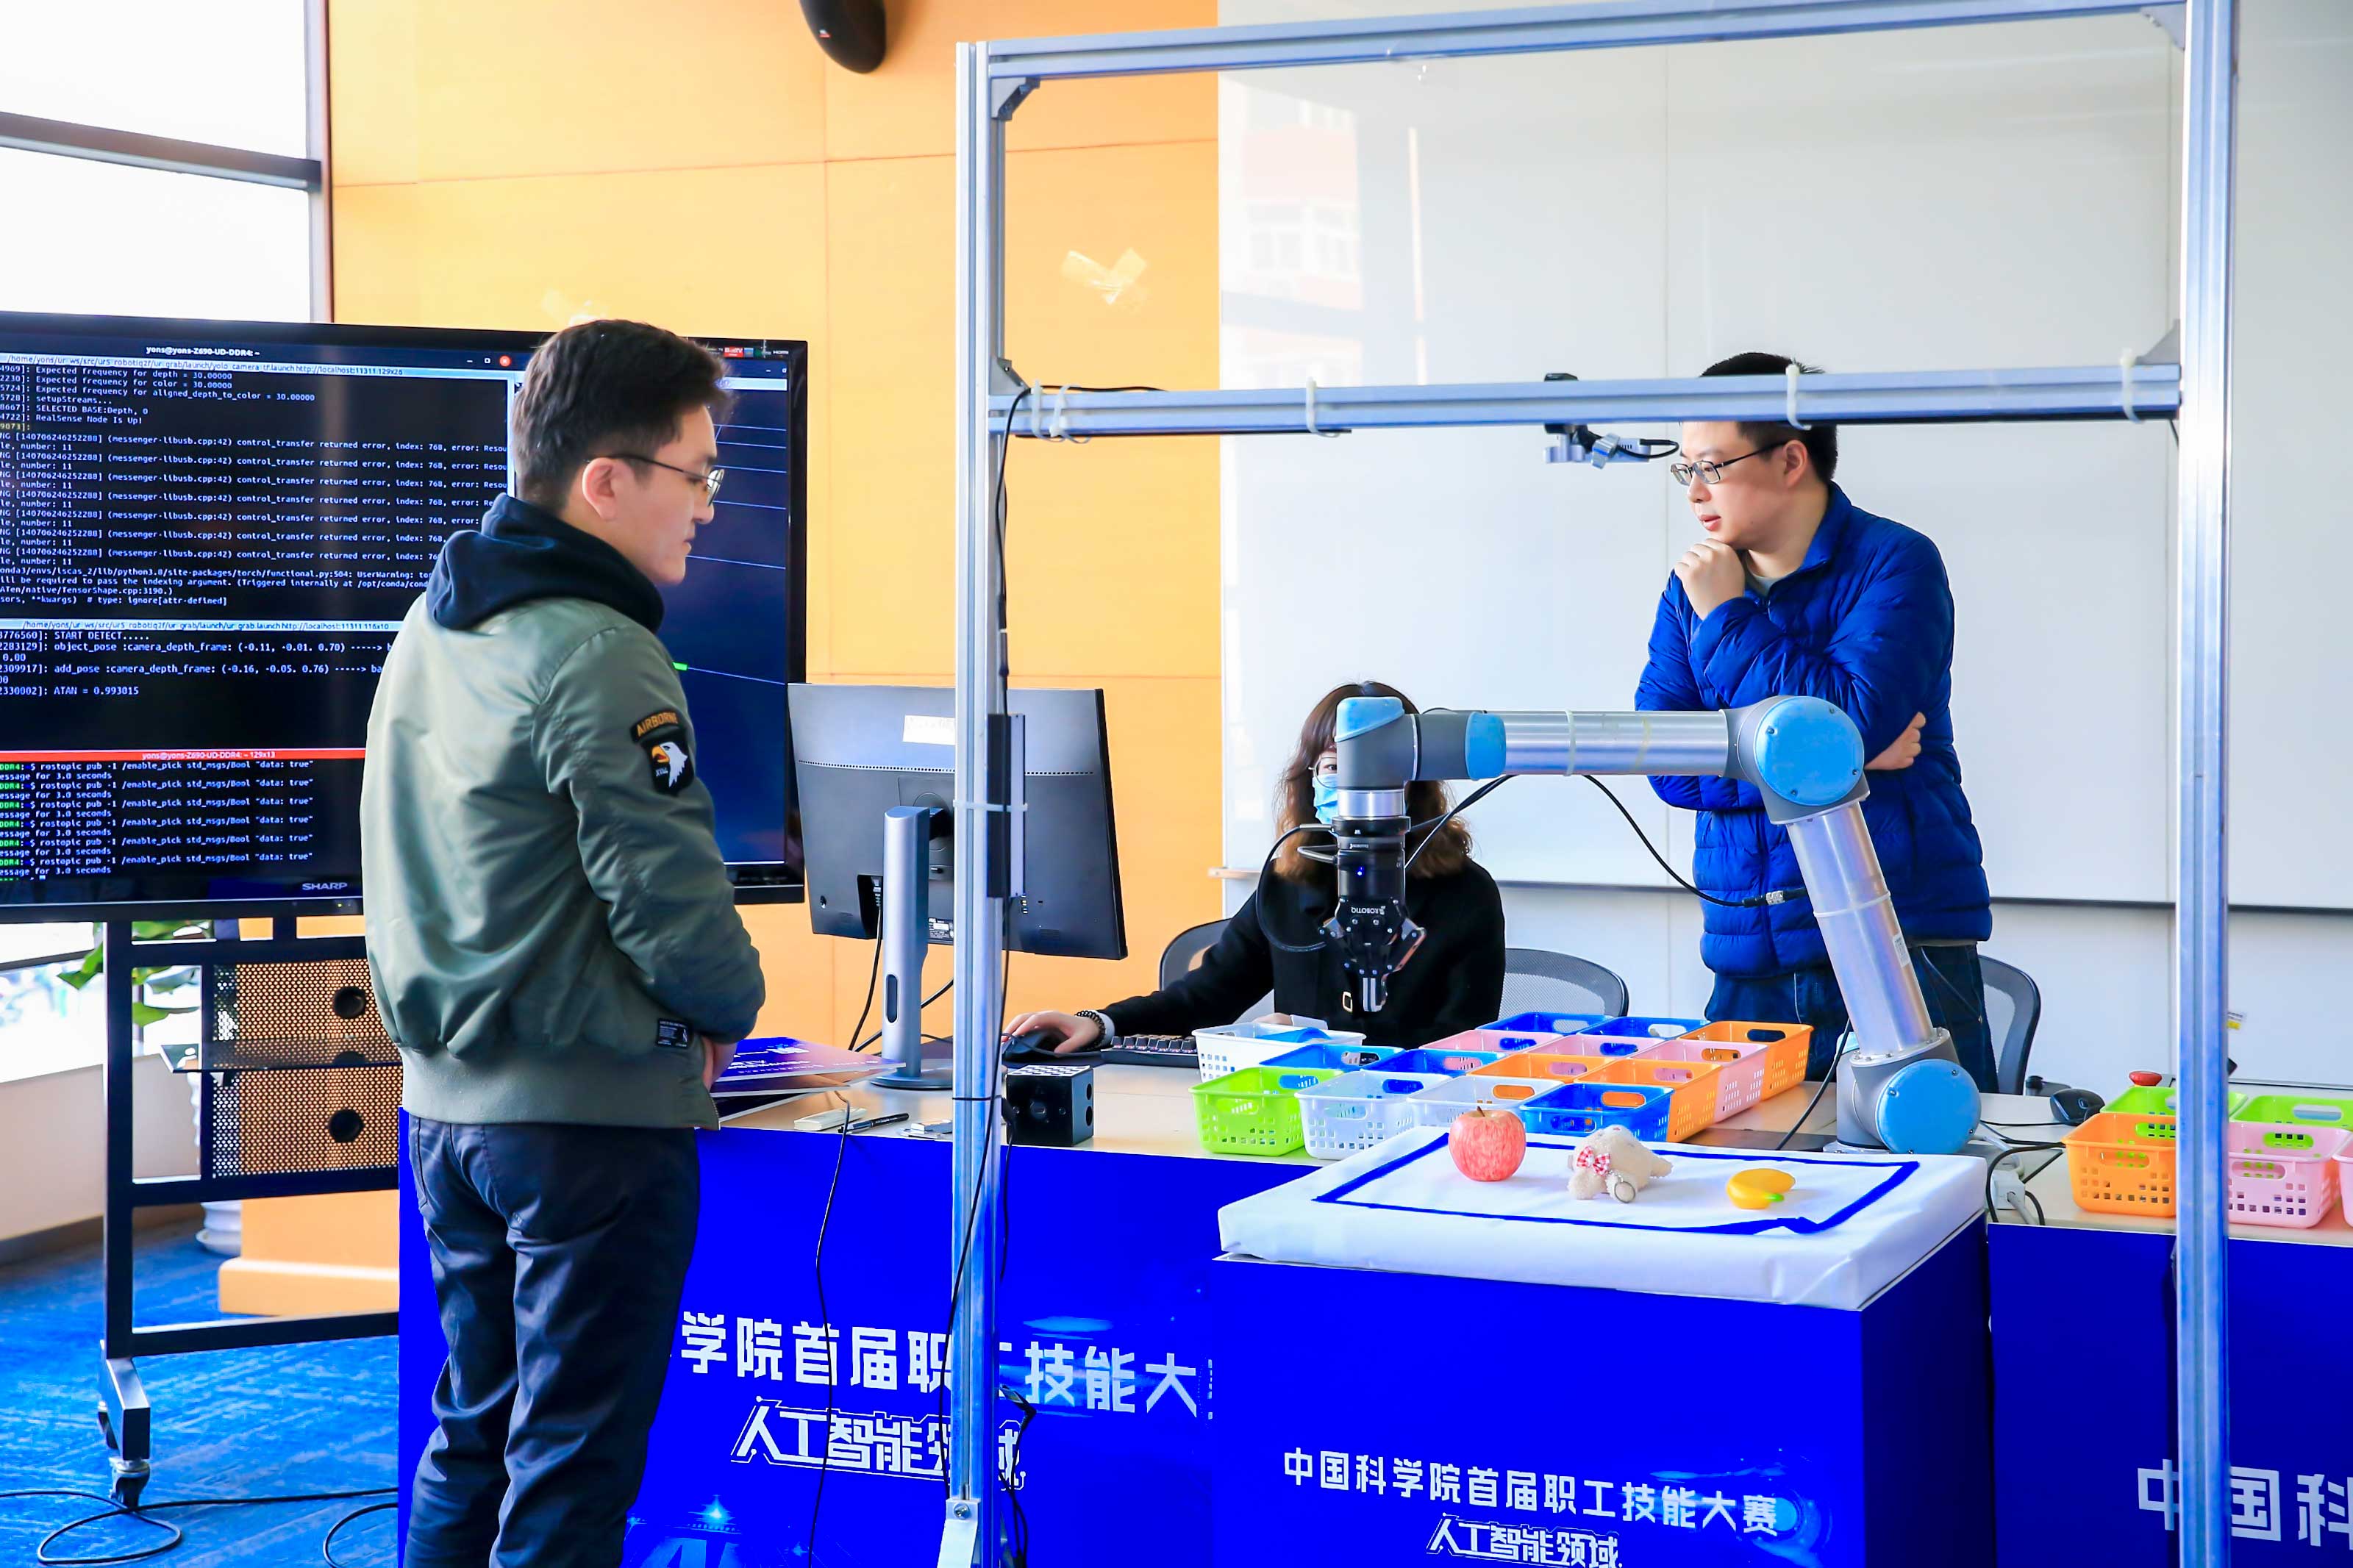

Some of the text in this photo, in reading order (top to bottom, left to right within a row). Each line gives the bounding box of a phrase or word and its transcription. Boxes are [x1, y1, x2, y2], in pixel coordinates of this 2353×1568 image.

[637, 711, 678, 737] AIRBORNE
[302, 882, 347, 890] SHARP
[681, 1311, 1212, 1420] 学院首届职技能大
[1284, 1447, 1778, 1536] 中国科学院首届职工技能大赛
[1429, 1518, 1618, 1568] 人工智能领域
